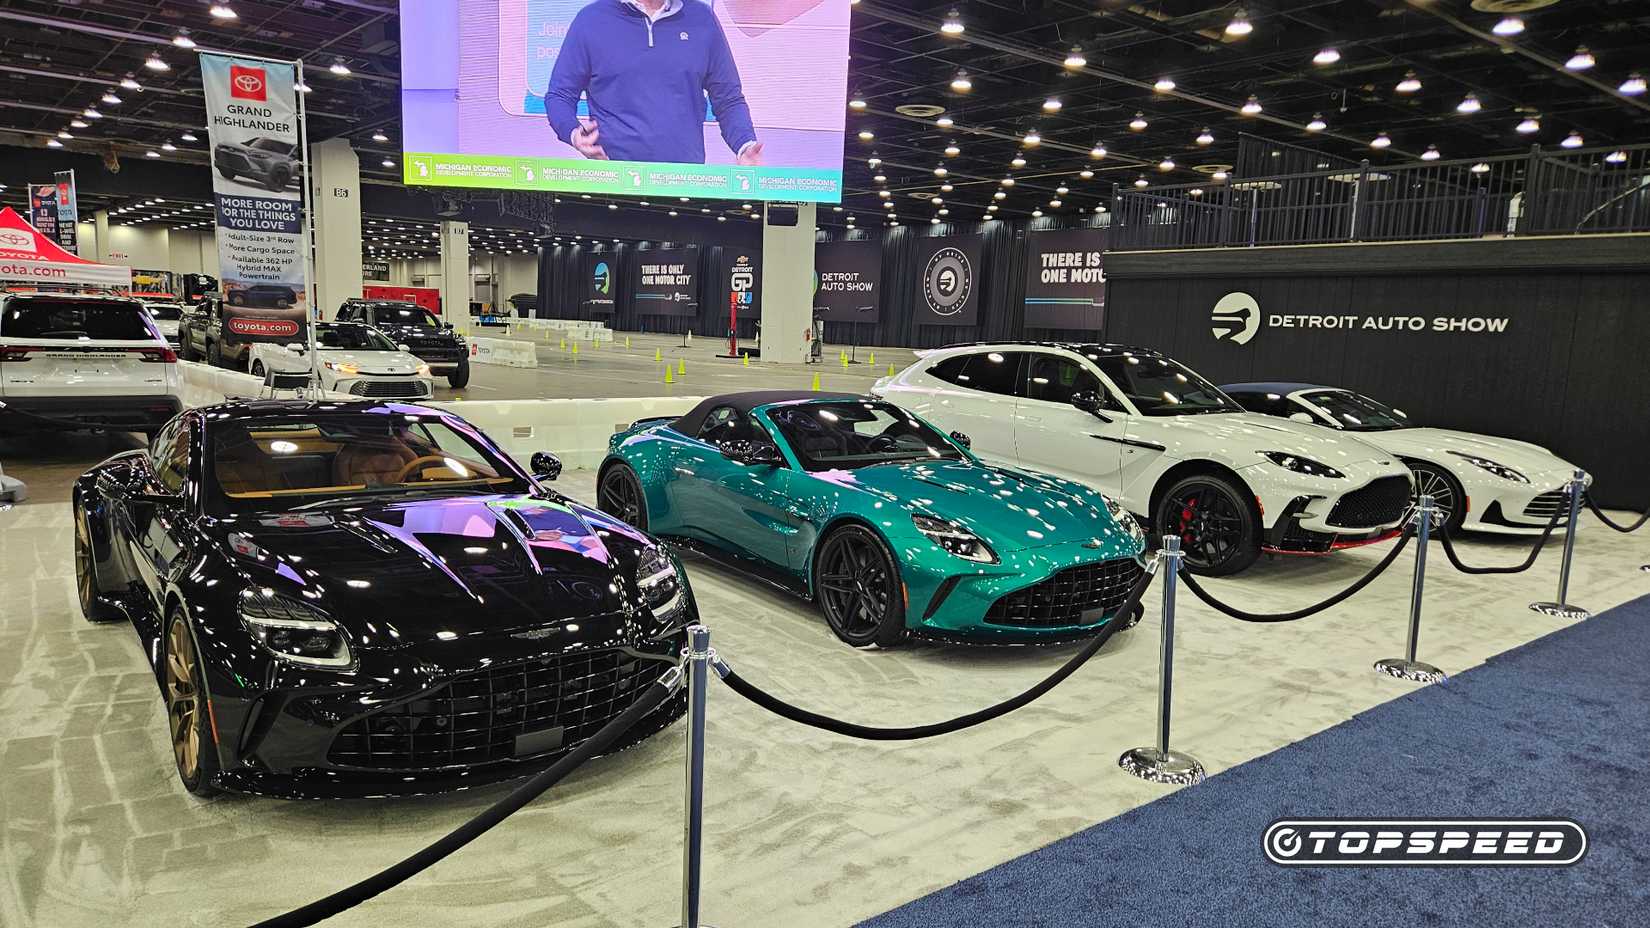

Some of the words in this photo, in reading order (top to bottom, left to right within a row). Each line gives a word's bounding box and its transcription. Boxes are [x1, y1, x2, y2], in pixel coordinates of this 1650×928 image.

[227, 104, 272, 118] GRAND
[214, 115, 290, 133] HIGHLANDER
[221, 198, 253, 208] MORE
[255, 201, 292, 211] ROOM
[239, 209, 256, 219] THE
[258, 210, 296, 222] THINGS
[229, 218, 253, 228] YOU
[255, 220, 285, 230] LOVE
[277, 236, 295, 244] Row
[246, 246, 270, 254] Cargo
[271, 247, 295, 255] Space
[265, 257, 280, 265] 362
[1041, 252, 1083, 267] THERE
[1086, 251, 1101, 267] IS
[236, 263, 261, 272] Hybrid
[641, 265, 659, 274] THERE
[660, 265, 667, 274] IS
[668, 264, 684, 274] ONLY
[239, 272, 280, 280] Powertrain
[641, 275, 654, 285] ONE
[655, 275, 675, 285] MOTOR
[676, 275, 691, 285] CITY
[821, 273, 859, 281] DETROIT
[1041, 269, 1067, 283] ONE
[731, 272, 753, 292] GP
[821, 282, 844, 291] AUTO
[846, 282, 873, 291] SHOW
[233, 321, 292, 332] toyota.com
[1269, 314, 1358, 329] DETROIT
[1362, 316, 1426, 331] AUTO
[1432, 317, 1509, 332] SHOW
